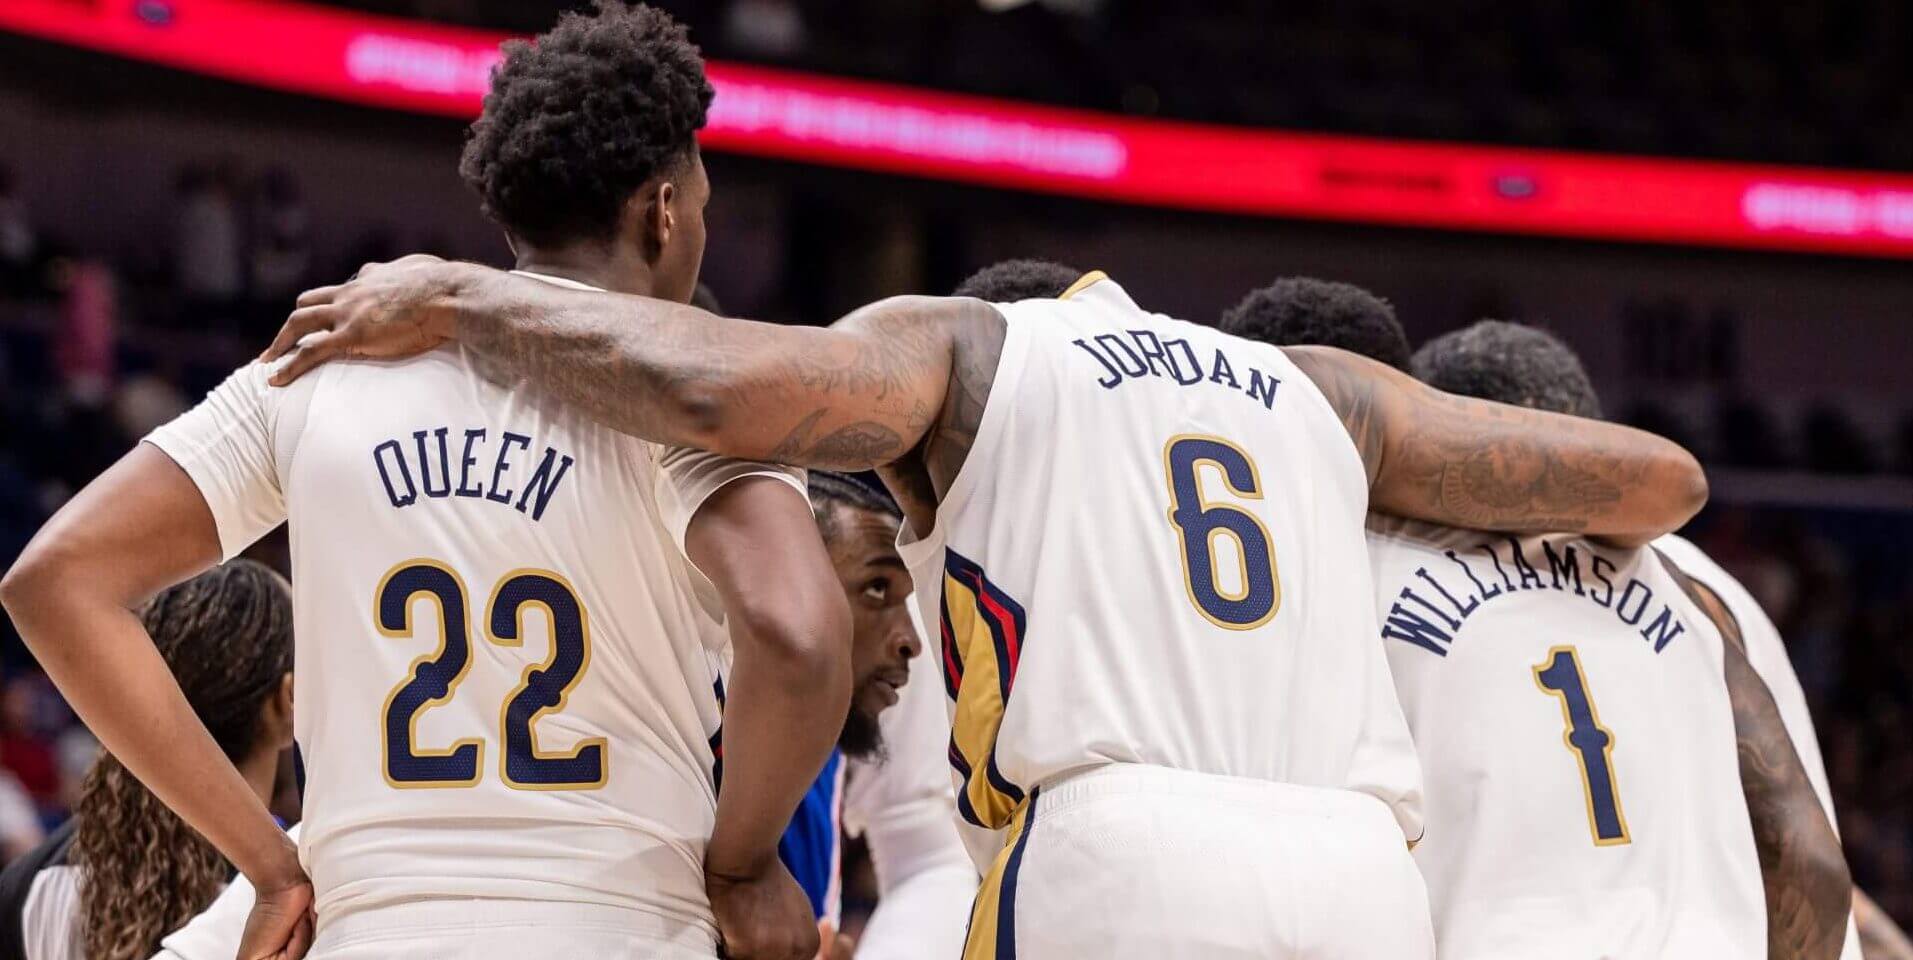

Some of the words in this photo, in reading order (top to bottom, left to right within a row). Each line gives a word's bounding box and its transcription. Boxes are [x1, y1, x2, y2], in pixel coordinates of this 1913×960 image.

[1072, 330, 1281, 410] JORDAN
[373, 427, 574, 521] QUEEN
[1163, 433, 1281, 631] 6
[373, 557, 608, 790] 22
[1381, 537, 1685, 657] WILLIAMSON
[1531, 645, 1632, 846] 1
